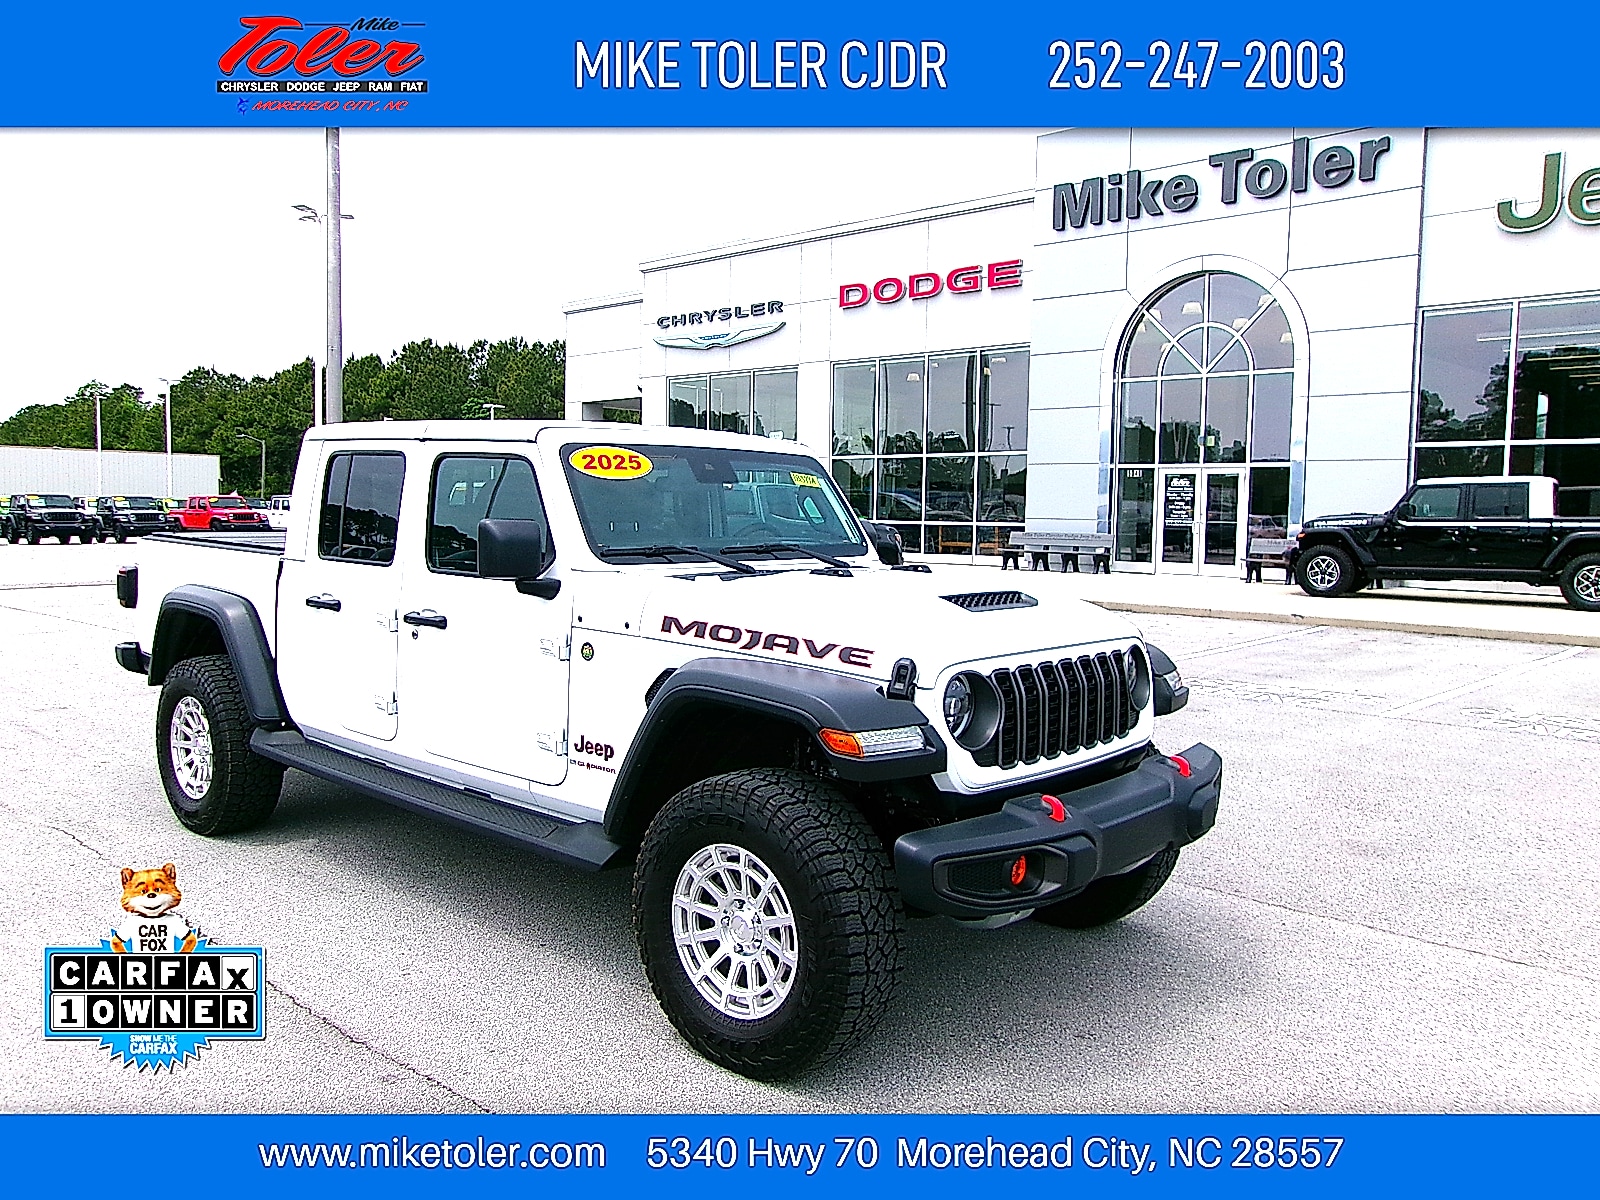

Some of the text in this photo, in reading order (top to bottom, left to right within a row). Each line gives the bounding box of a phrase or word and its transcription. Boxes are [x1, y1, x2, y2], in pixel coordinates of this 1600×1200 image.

[1052, 136, 1391, 231] Mike Toler
[838, 258, 1024, 310] DODGE
[656, 300, 785, 329] CHRYSLER
[581, 454, 643, 471] 2025
[660, 615, 875, 669] MOJAVE
[573, 734, 615, 762] Jeep
